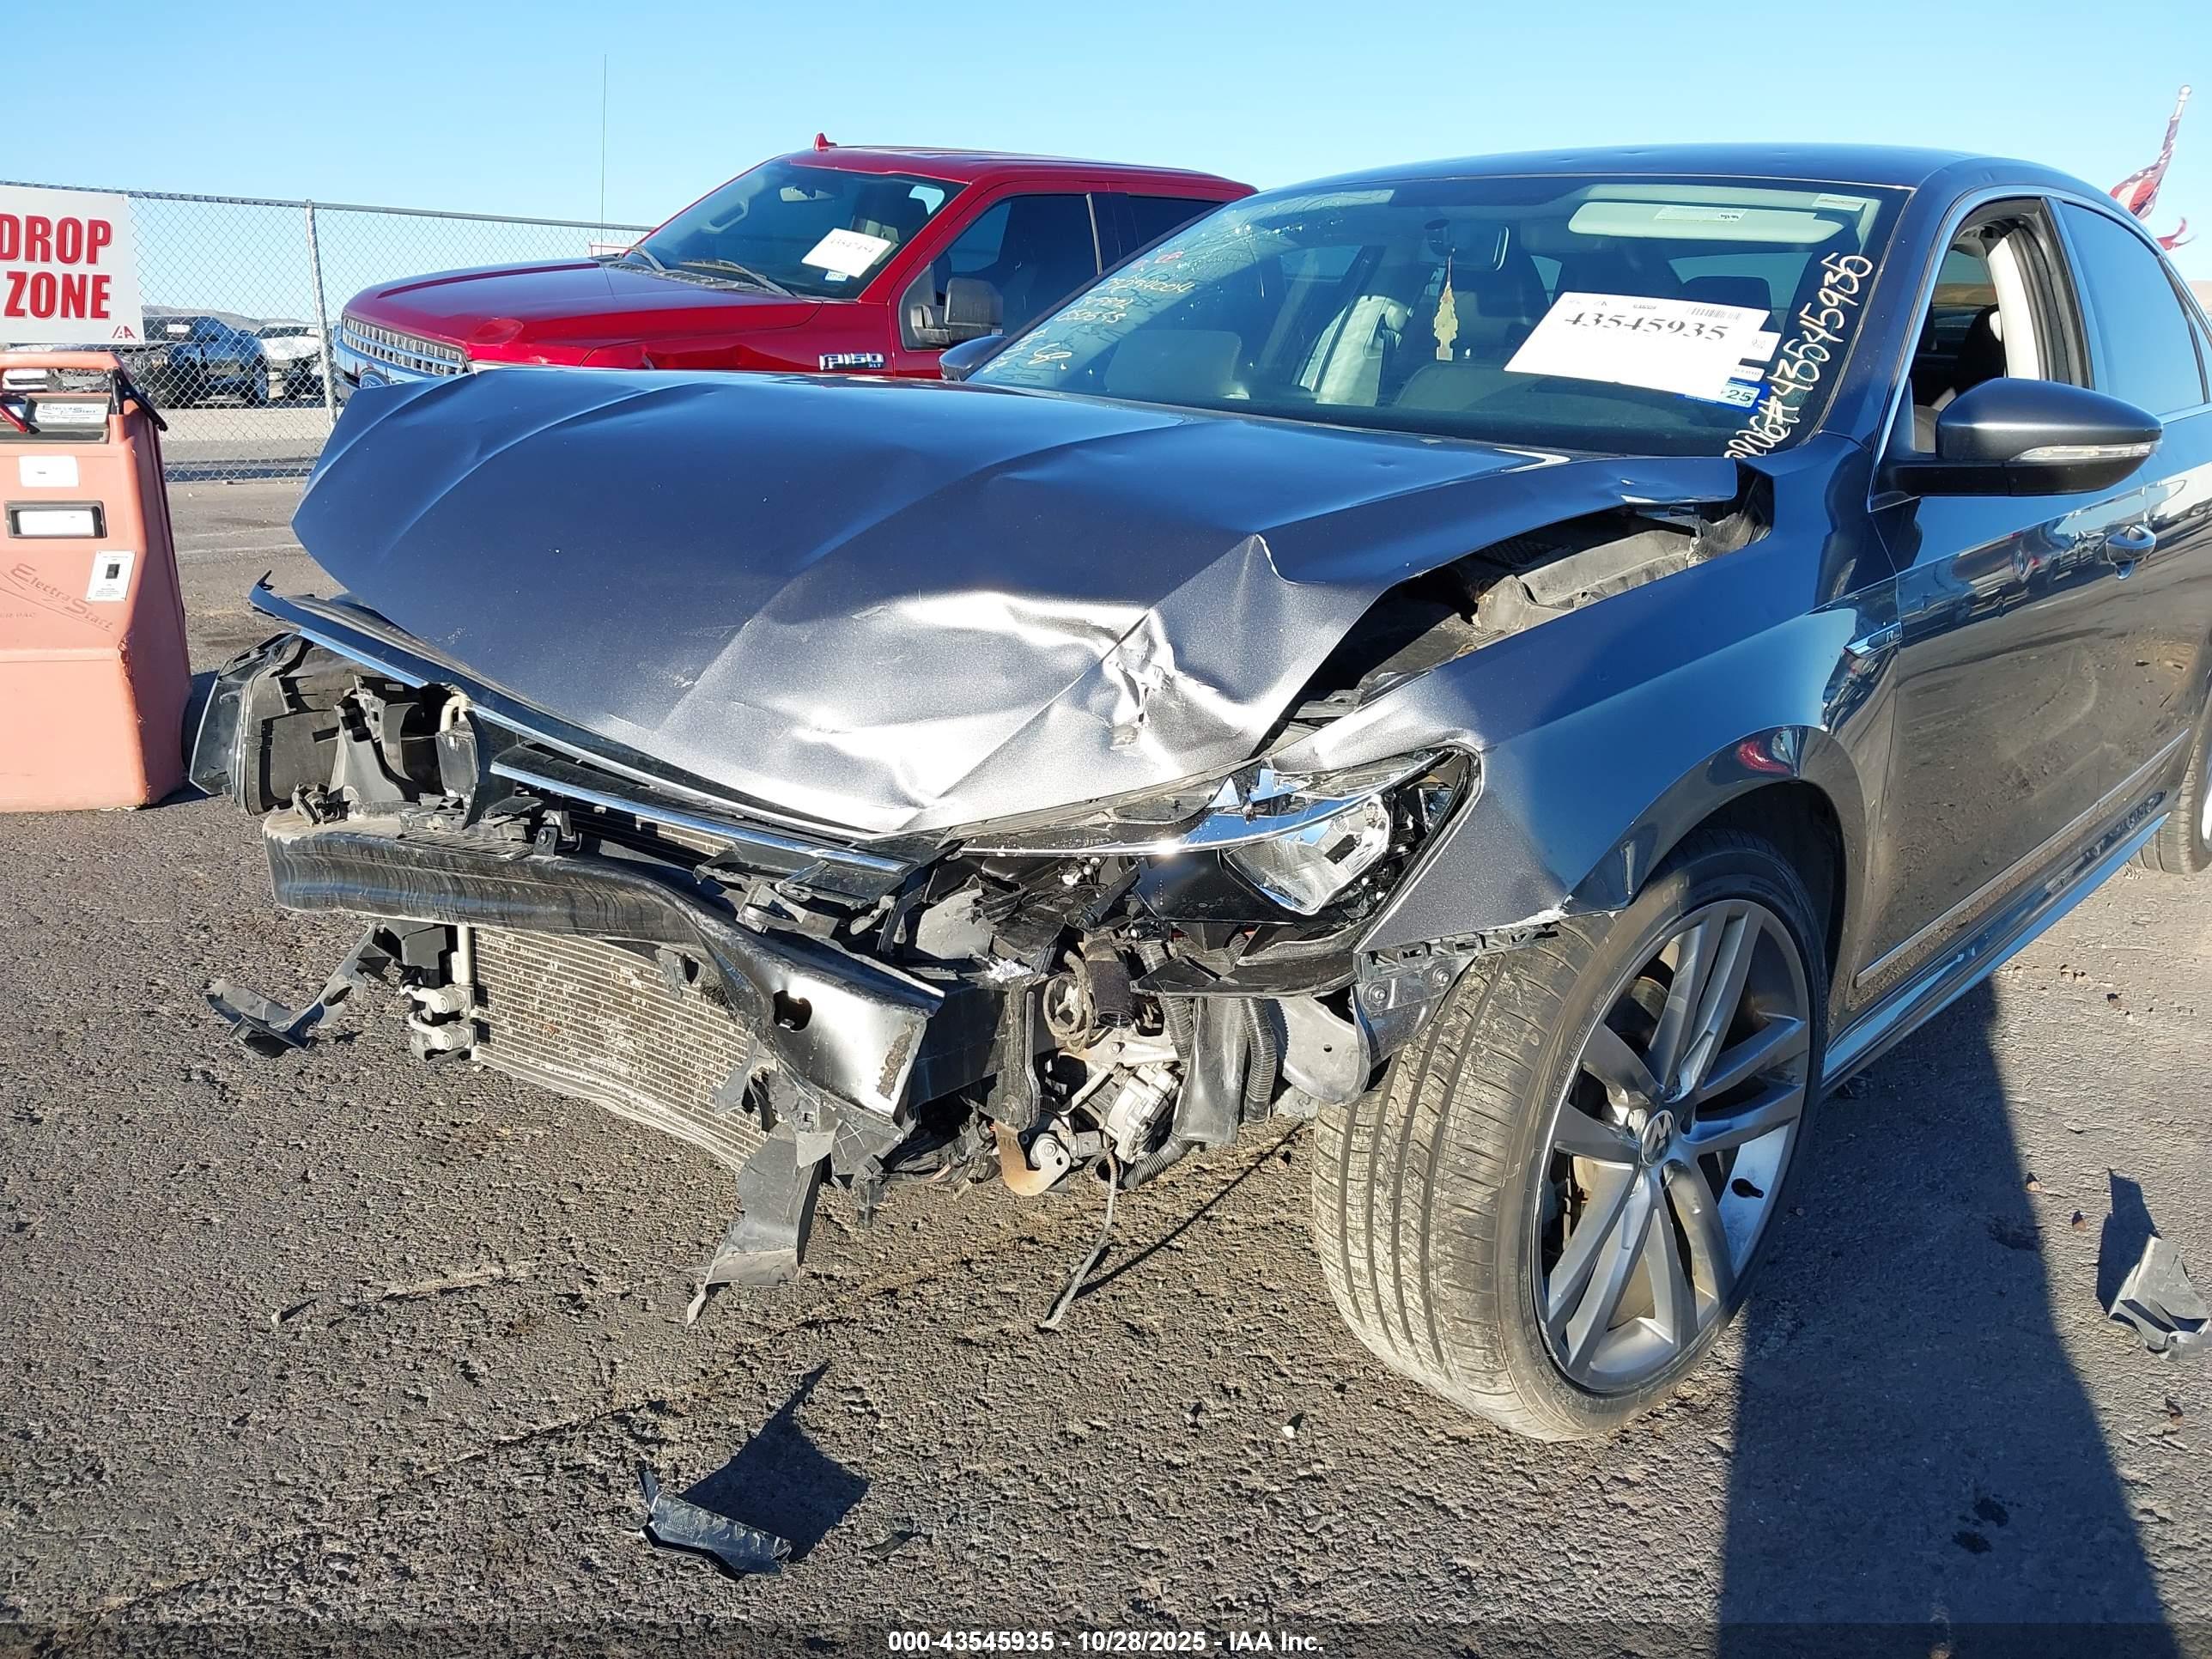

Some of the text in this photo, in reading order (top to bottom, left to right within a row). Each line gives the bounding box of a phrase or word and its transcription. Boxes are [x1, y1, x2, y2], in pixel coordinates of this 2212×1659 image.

[0, 213, 112, 265] DROP
[4, 270, 111, 319] ZONE
[1565, 311, 1729, 341] 43545935
[1726, 389, 1754, 402] 25
